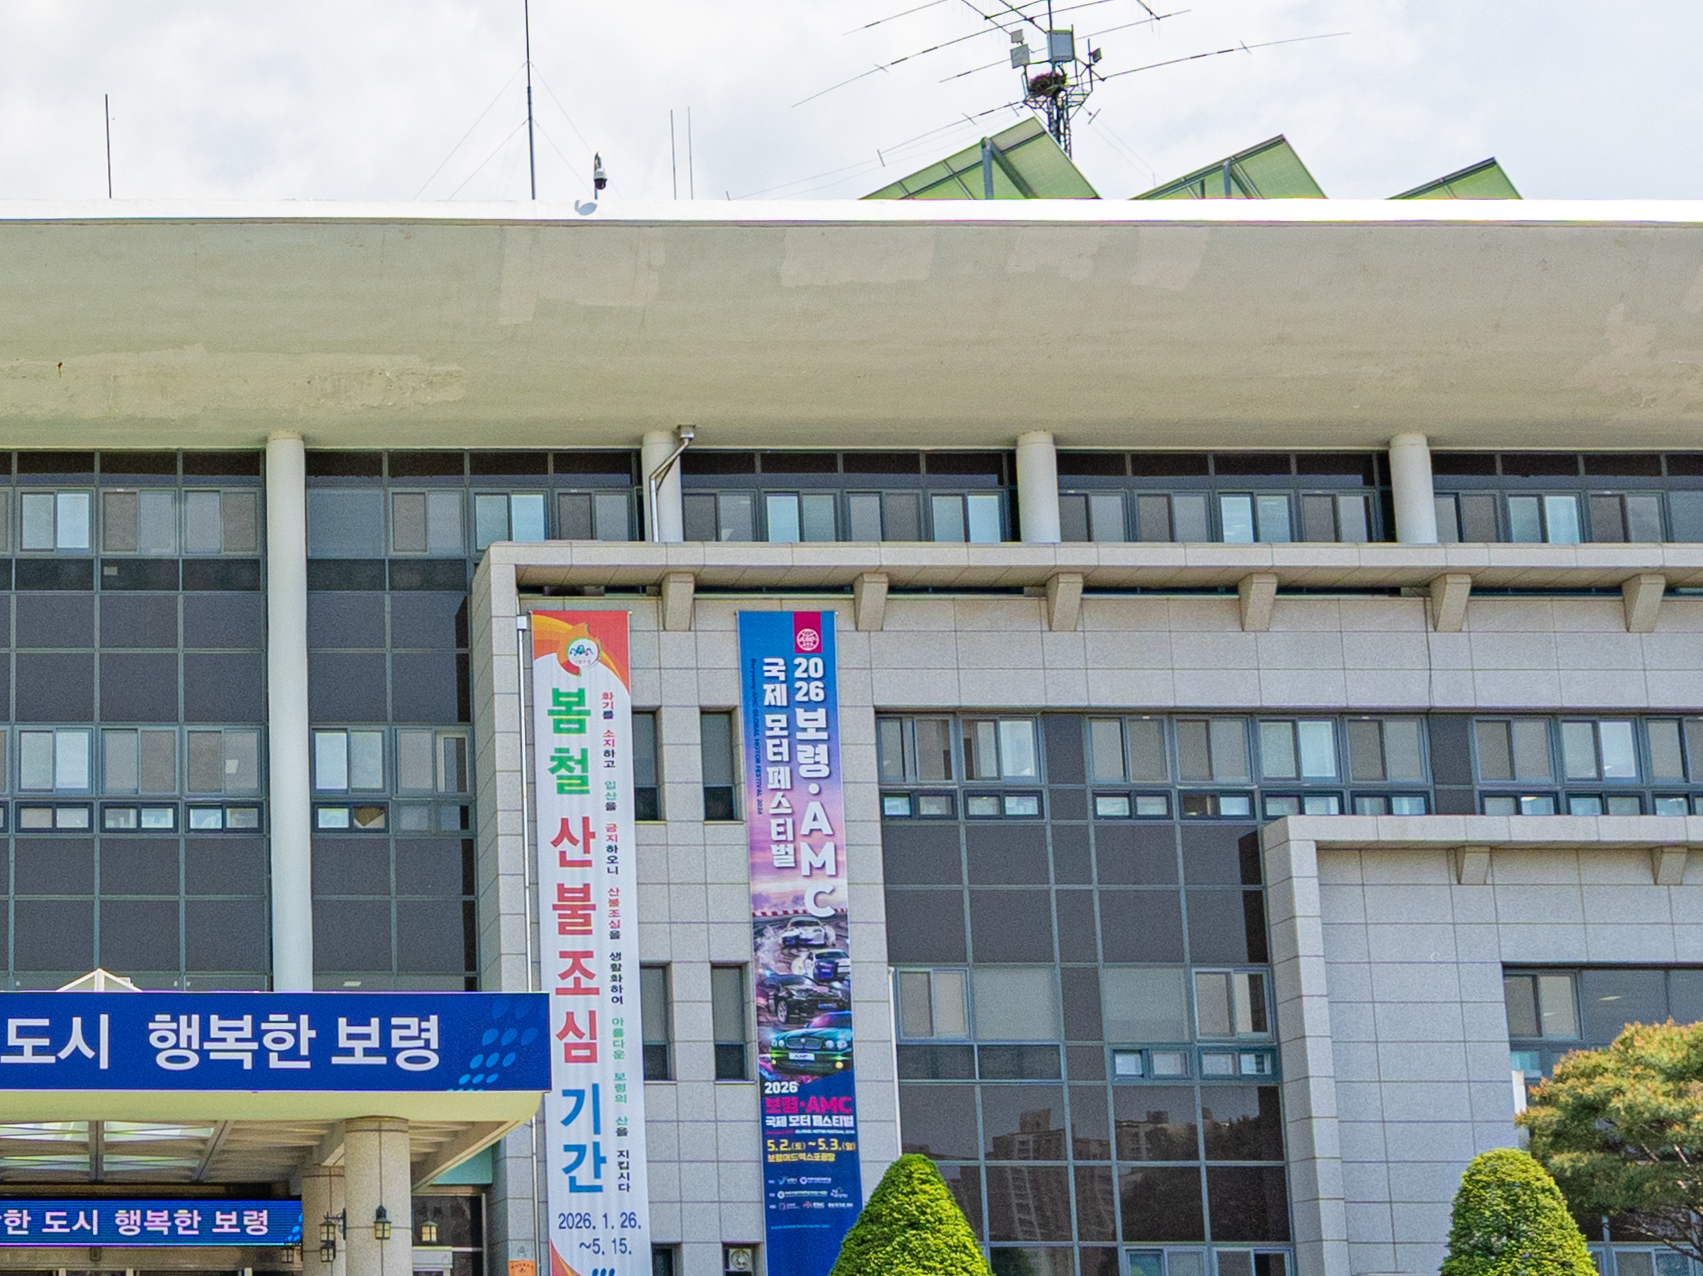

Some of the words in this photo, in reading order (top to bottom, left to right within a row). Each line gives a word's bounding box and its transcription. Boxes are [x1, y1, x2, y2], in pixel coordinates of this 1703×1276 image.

[762, 657, 788, 707] 국제
[601, 691, 615, 720] 화기를
[602, 729, 616, 768] 소지하고
[604, 781, 617, 811] 입산을
[605, 823, 619, 875] 금지하오니
[607, 887, 621, 940] 산불조심을
[609, 951, 623, 1005] 생활화하여
[0, 1012, 109, 1070] 도시
[148, 1013, 317, 1071] 행복한
[331, 1014, 440, 1071] 보령
[611, 1017, 625, 1060] 아름다운
[613, 1072, 627, 1104] 보령의
[764, 1081, 798, 1094] 2026
[615, 1116, 628, 1137] 산을
[765, 1115, 787, 1127] 국제
[617, 1149, 631, 1193] 지킵시다
[42, 1209, 99, 1236] 도시
[114, 1209, 202, 1236] 행복한
[211, 1209, 269, 1236] 보령
[558, 1212, 596, 1230] 2026.
[602, 1212, 614, 1229] 1.
[620, 1211, 642, 1229] 26.
[611, 1237, 632, 1255] 15.
